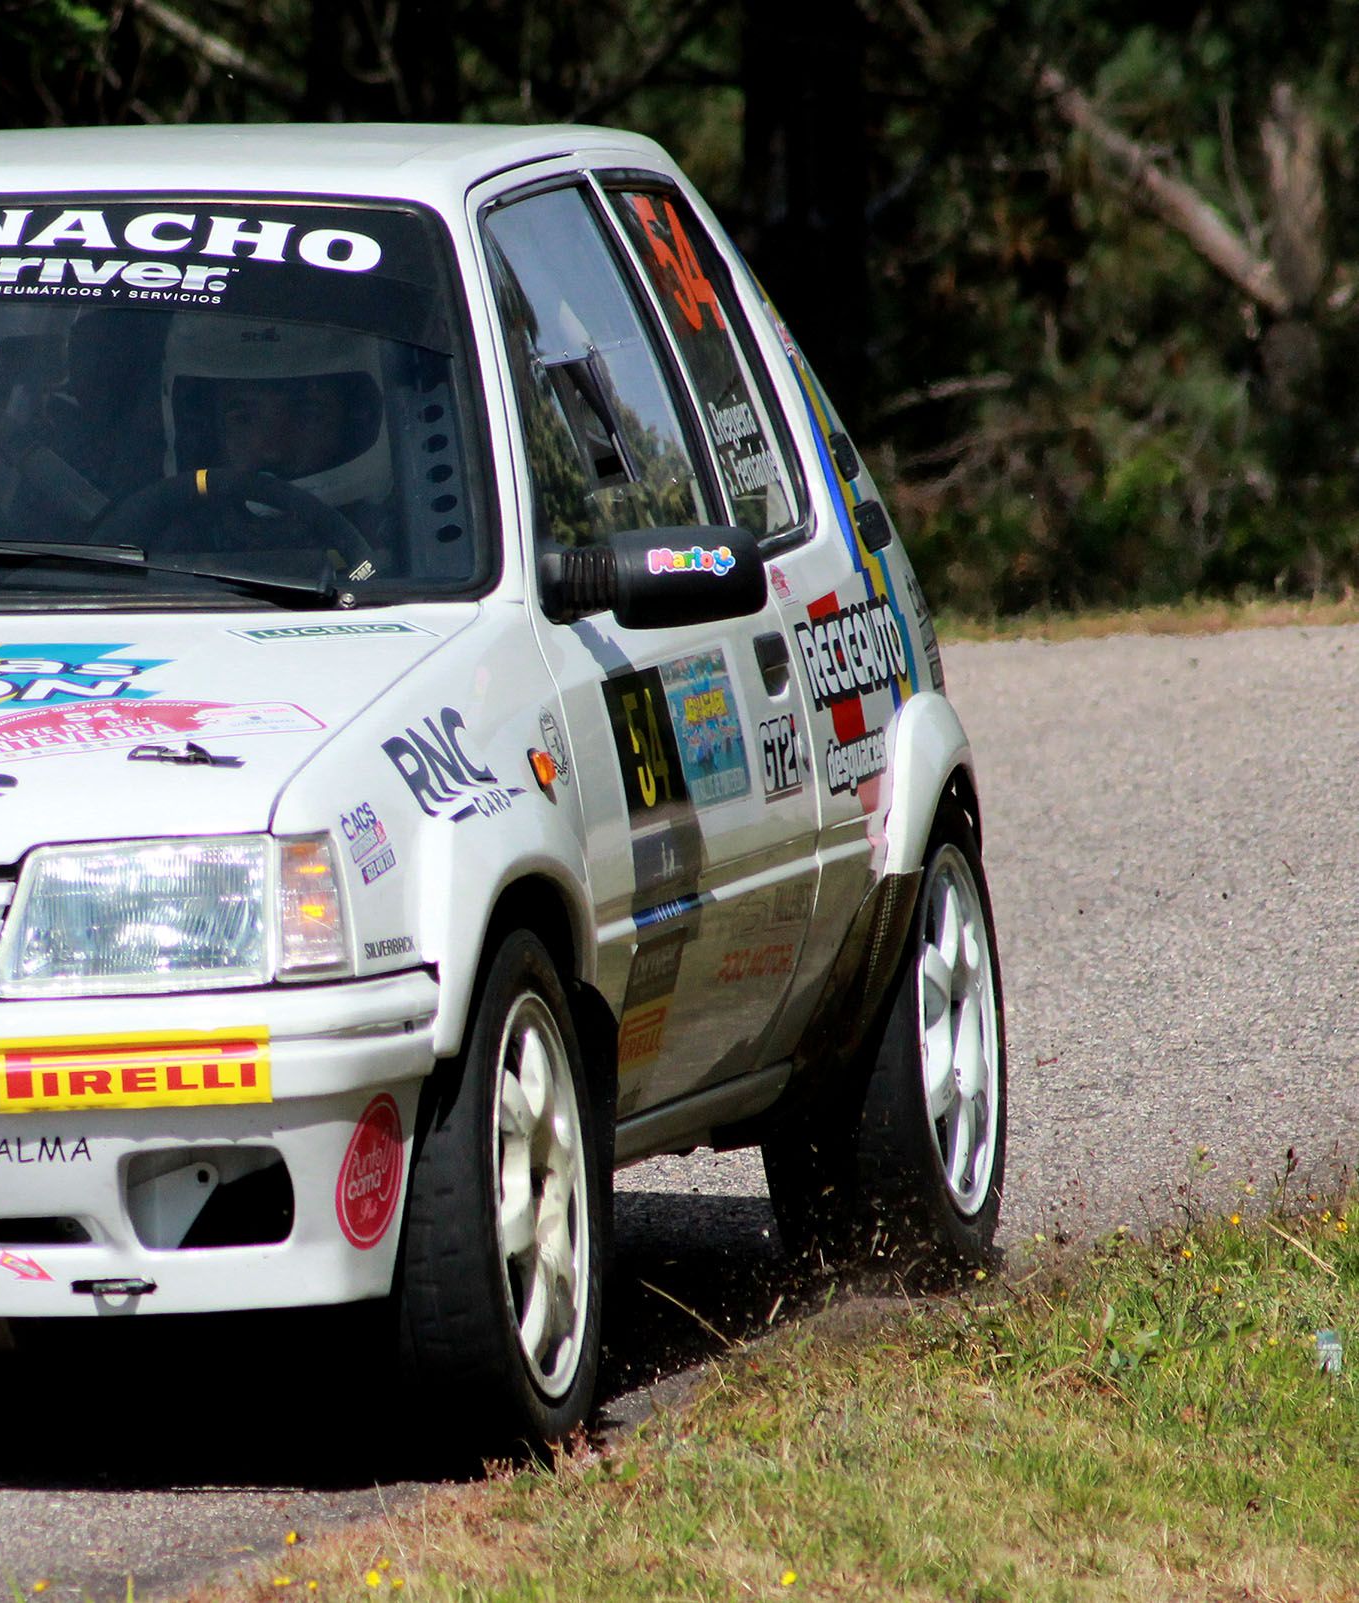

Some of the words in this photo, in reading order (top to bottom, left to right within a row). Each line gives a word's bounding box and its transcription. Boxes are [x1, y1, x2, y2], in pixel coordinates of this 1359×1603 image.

[632, 194, 725, 331] 54
[111, 289, 121, 298] Y
[128, 290, 222, 304] SERVICIOS
[257, 623, 402, 638] LUCEIRO
[58, 722, 92, 732] DE
[62, 708, 123, 722] 54
[621, 688, 673, 807] 54
[380, 706, 498, 818] RNC
[472, 788, 512, 818] CARS
[364, 936, 416, 960] SILVERBACK
[5, 1041, 260, 1099] PIRELLI
